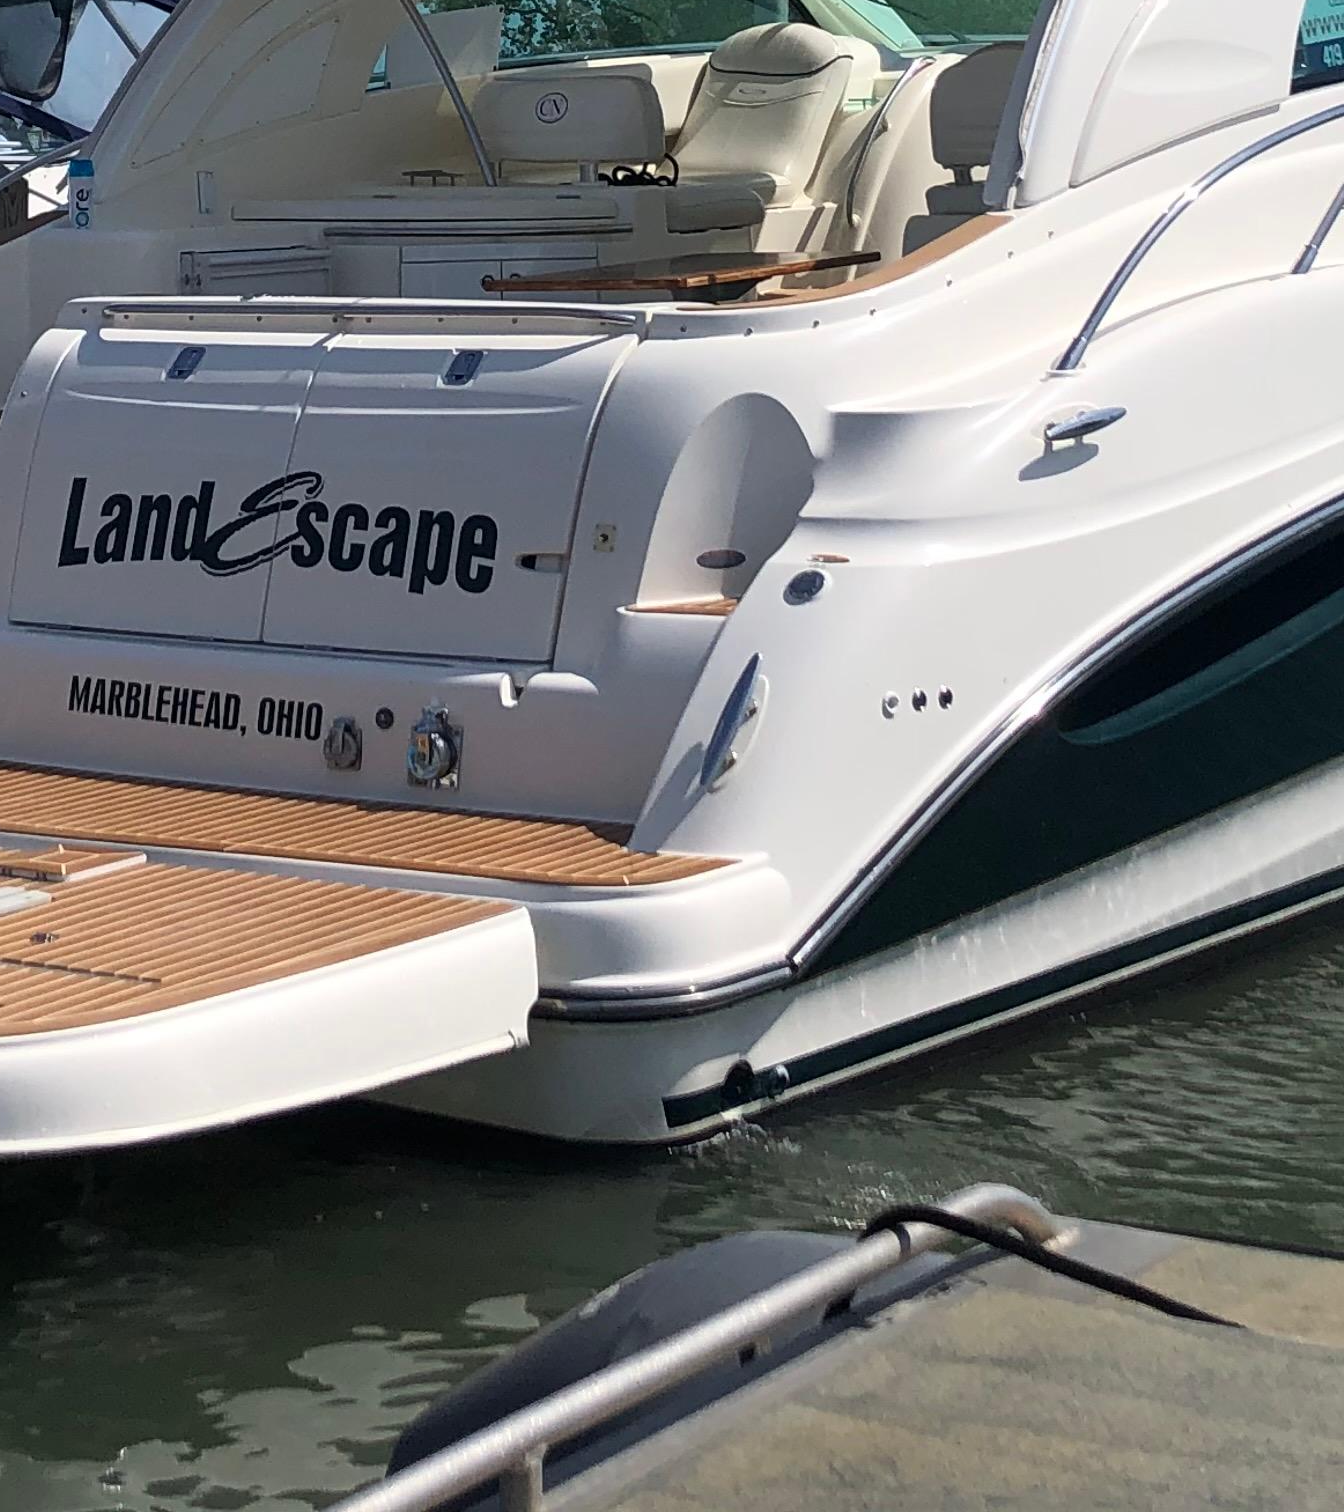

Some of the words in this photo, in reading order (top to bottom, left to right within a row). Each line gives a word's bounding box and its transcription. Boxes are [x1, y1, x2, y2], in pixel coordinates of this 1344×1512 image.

[1302, 13, 1344, 38] WWW
[58, 471, 498, 595] LandEscape
[68, 675, 247, 736] MARBLEHEAD,
[257, 696, 323, 741] OHIO
